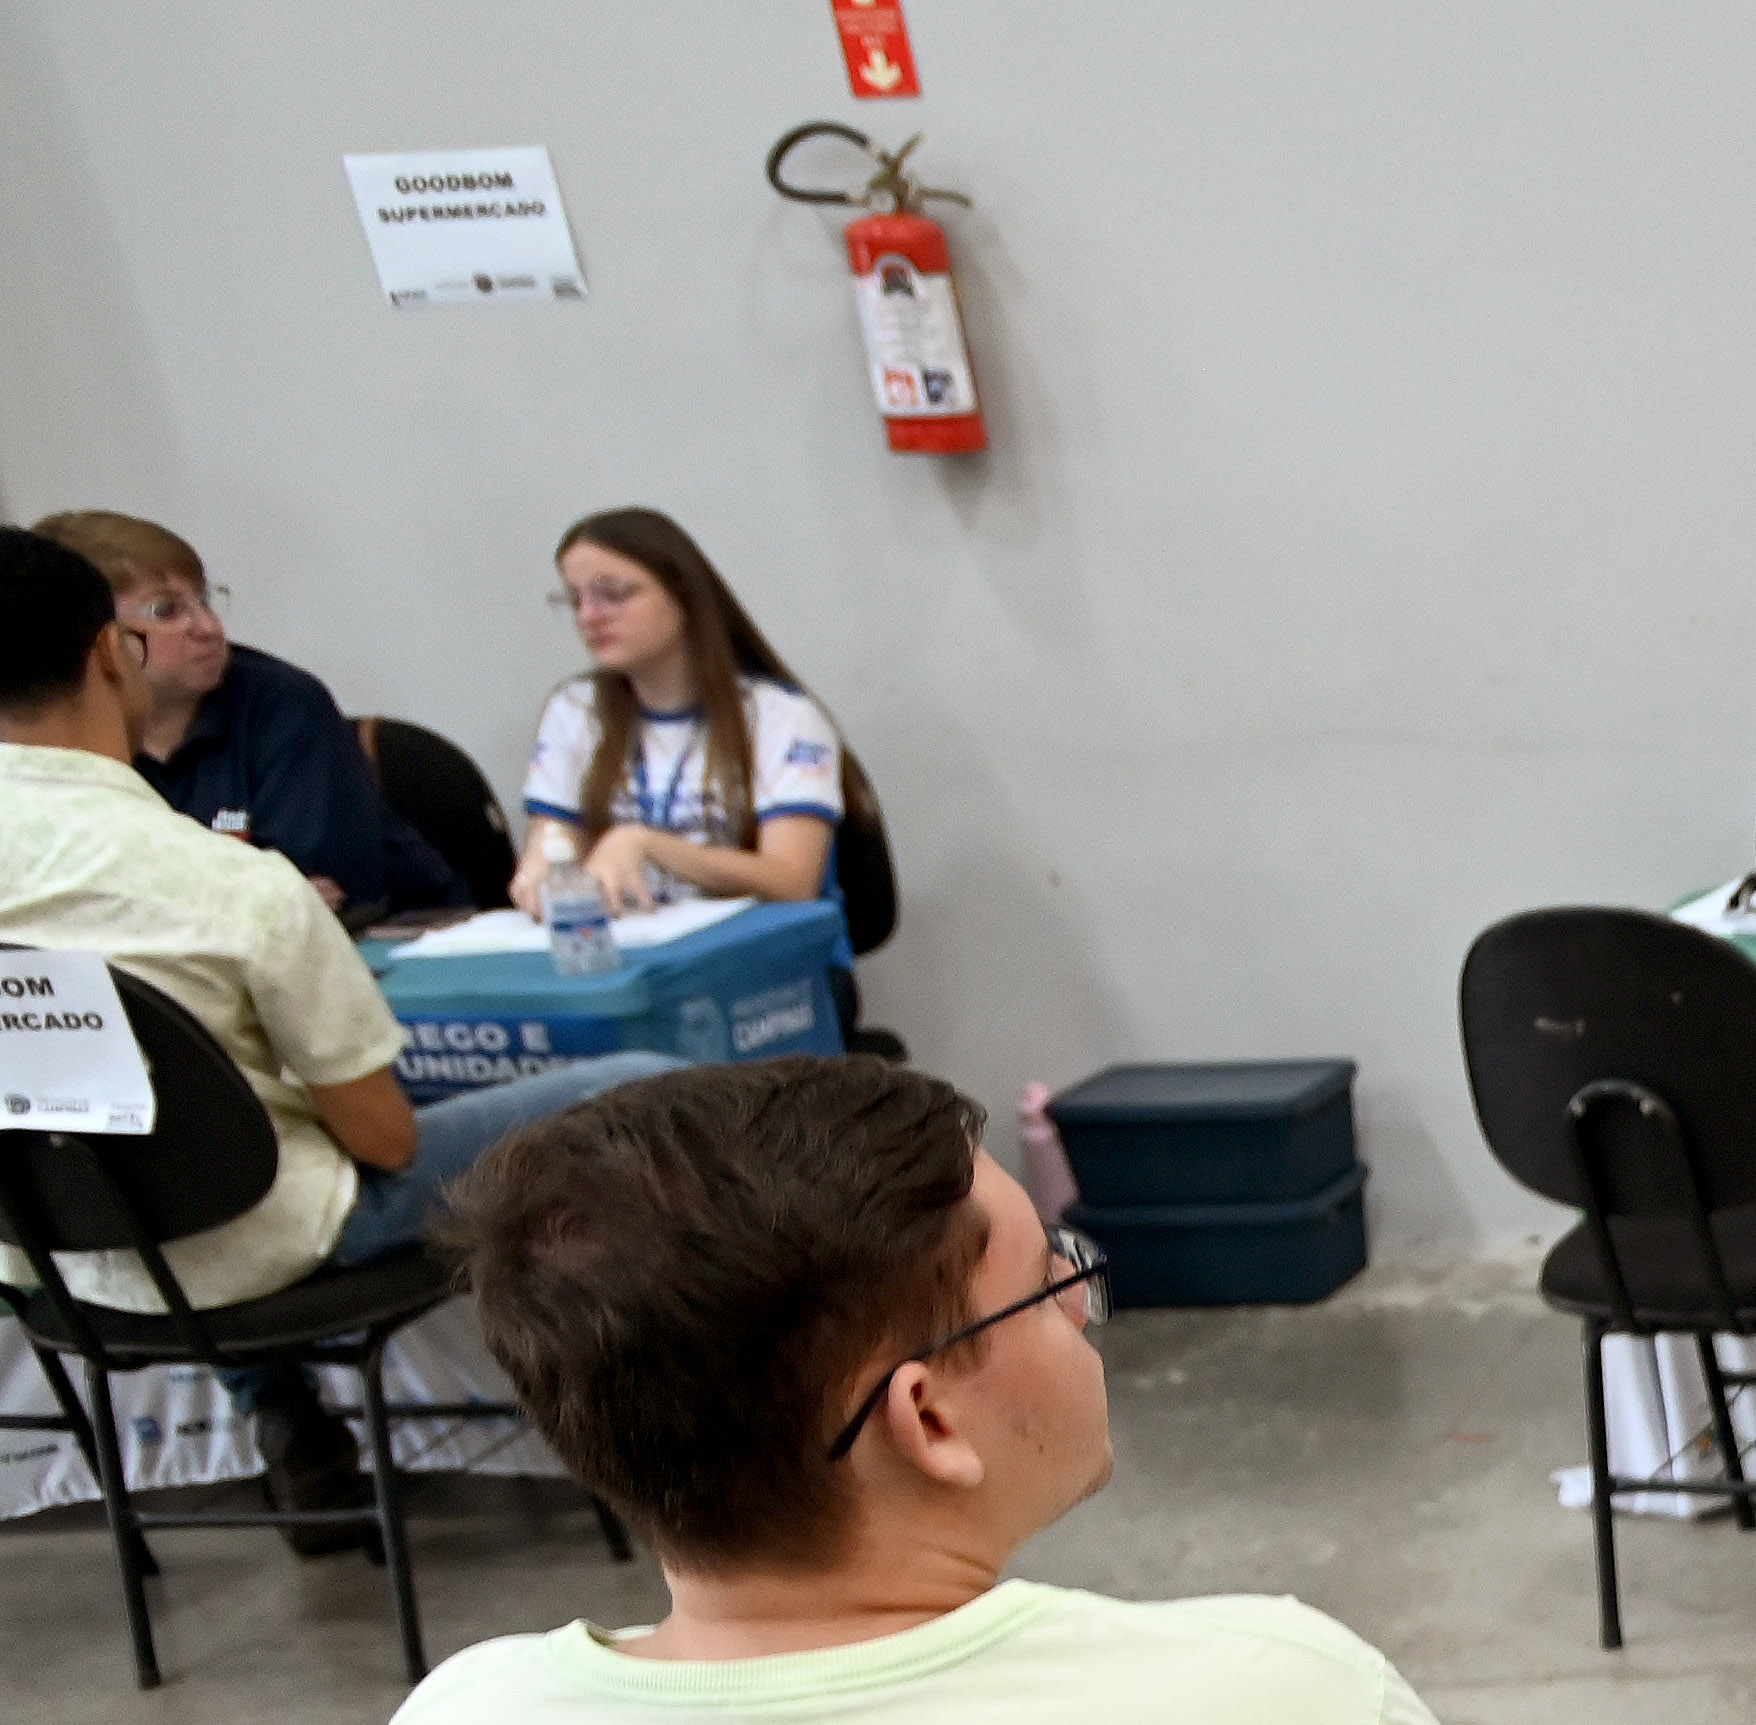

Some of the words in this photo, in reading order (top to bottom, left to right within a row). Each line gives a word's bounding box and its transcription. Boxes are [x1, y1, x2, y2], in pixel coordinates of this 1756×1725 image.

[395, 171, 514, 194] GOODBOM
[377, 200, 546, 223] SUPERMERCADO
[0, 1011, 104, 1032] RCADO
[404, 1021, 510, 1052] EGO
